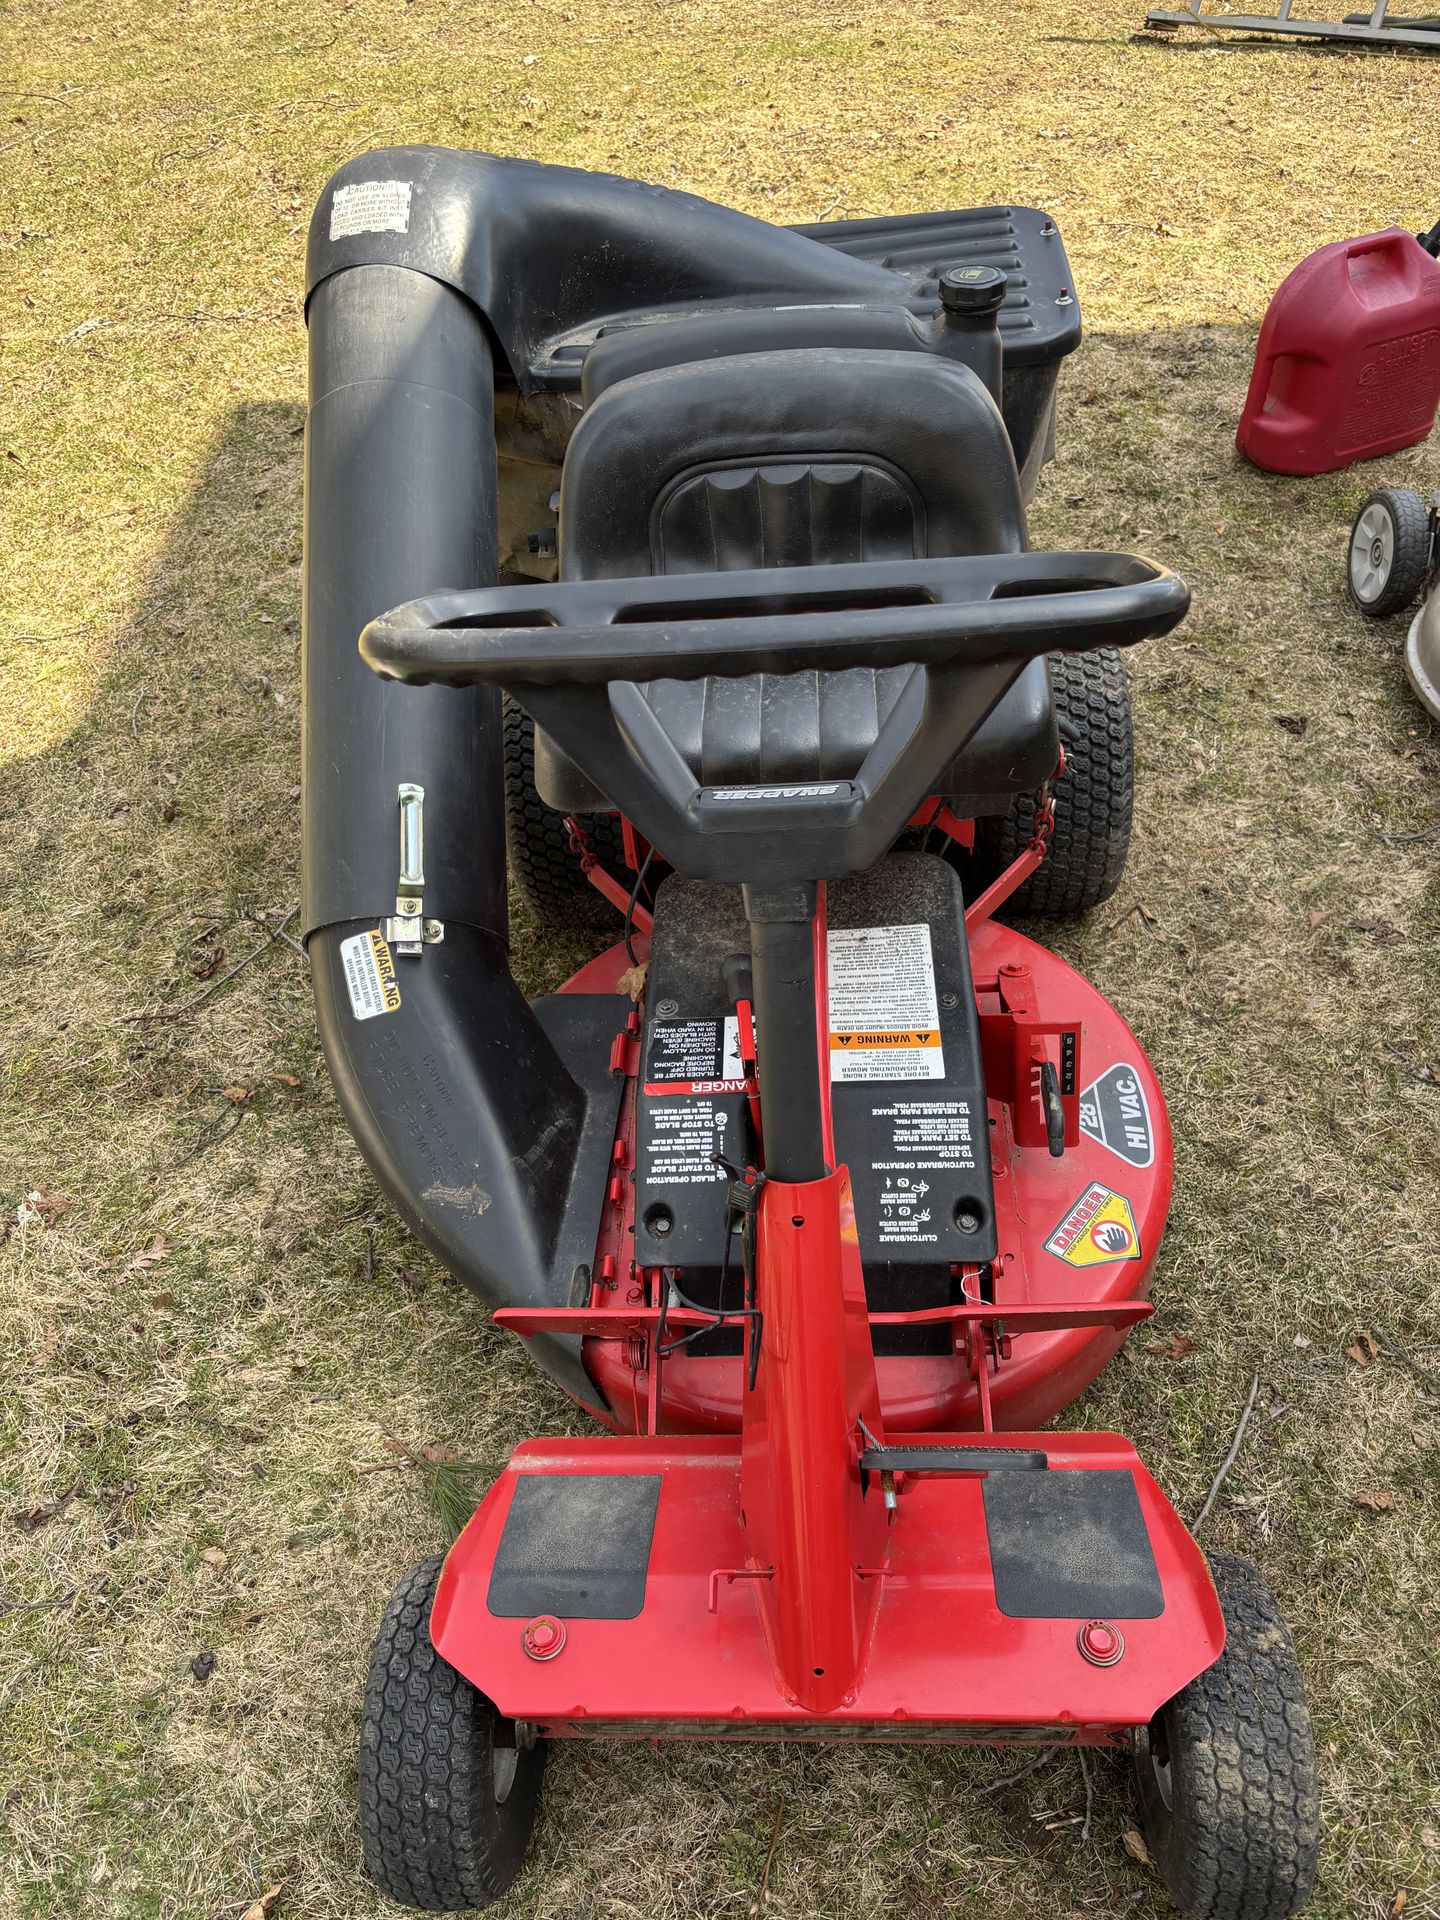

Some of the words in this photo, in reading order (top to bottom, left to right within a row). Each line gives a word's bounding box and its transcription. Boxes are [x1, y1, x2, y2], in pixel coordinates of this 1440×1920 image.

[713, 786, 838, 800] SNAPPER
[353, 946, 361, 959] MUST
[358, 966, 368, 991] INSTALLED
[363, 991, 372, 1008] BEFORE
[366, 959, 375, 975] ENTIRE
[376, 946, 399, 1007] WARNNG
[369, 976, 378, 991] GRASS
[373, 991, 383, 1012] CATCHER
[857, 1035, 910, 1044] WARNING
[692, 1081, 747, 1092] ANGER
[1116, 1080, 1141, 1119] VAC
[1124, 1125, 1148, 1149] HI
[1053, 1191, 1105, 1249] DANGER
[1067, 1243, 1076, 1256] KEEP
[1076, 1228, 1090, 1244] HANDS
